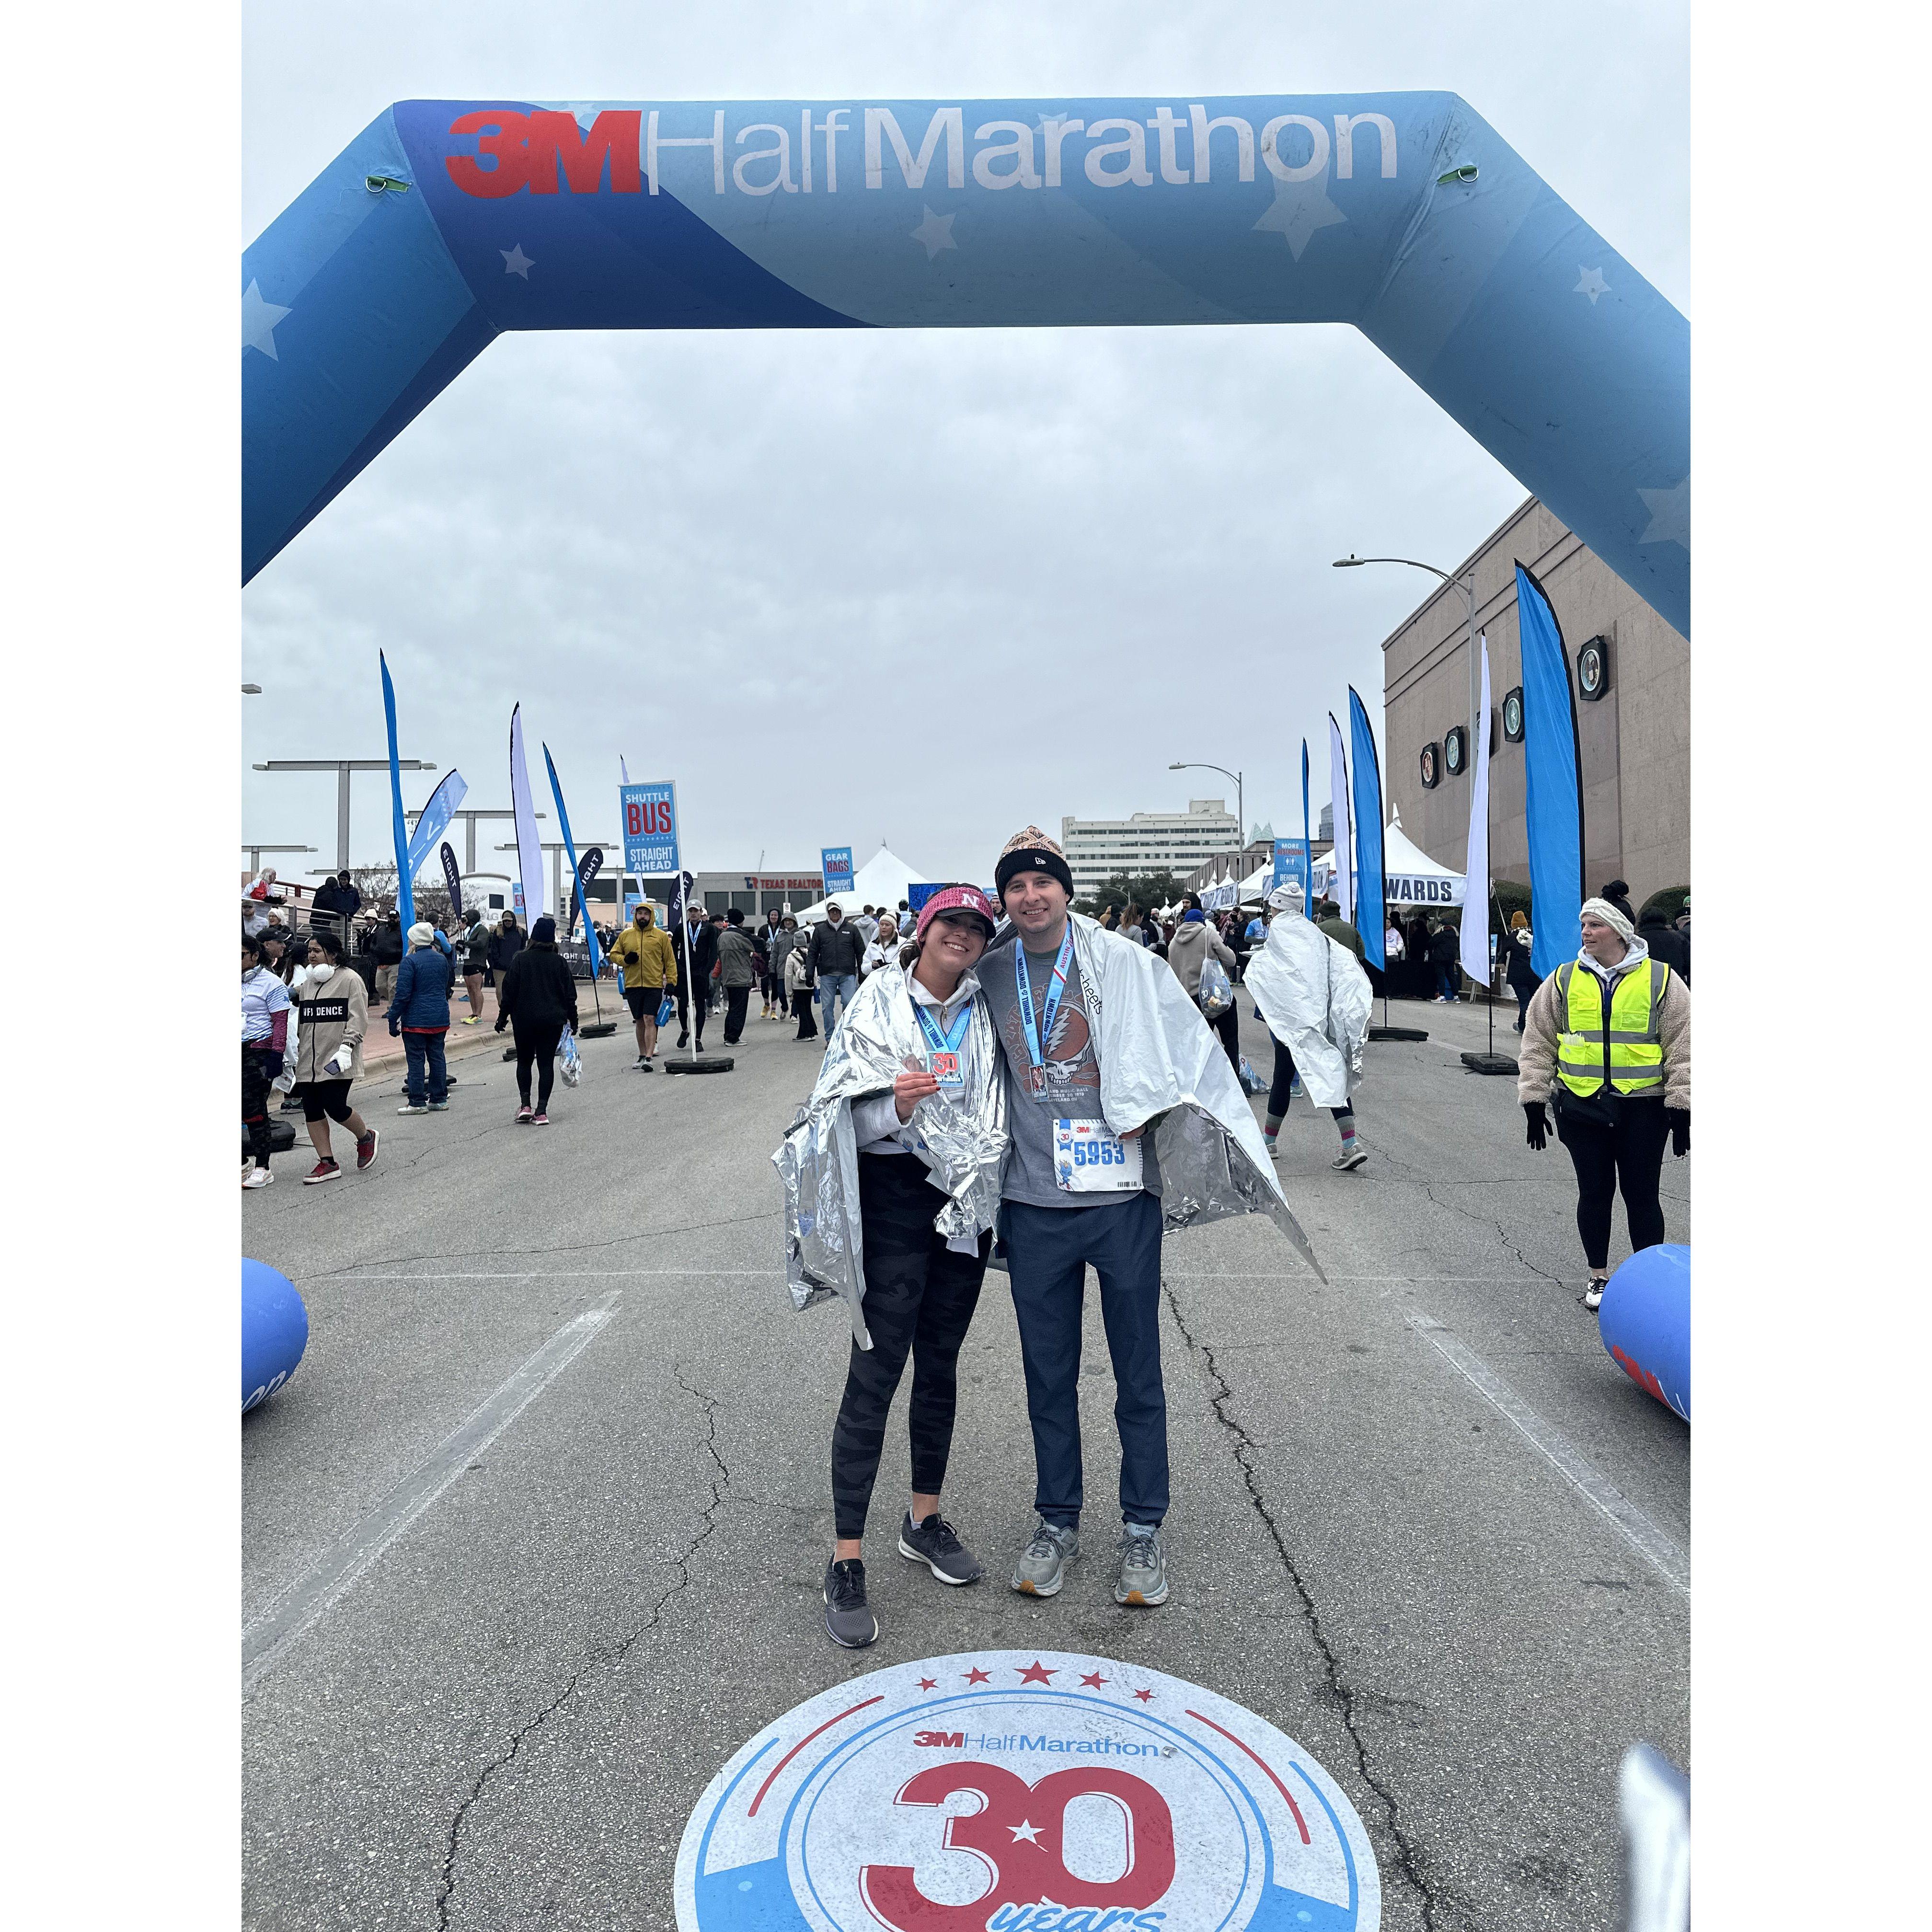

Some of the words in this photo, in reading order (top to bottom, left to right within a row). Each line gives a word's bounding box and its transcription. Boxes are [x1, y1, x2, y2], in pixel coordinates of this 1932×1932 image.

[445, 110, 642, 199] 3M
[647, 108, 851, 196] Half
[864, 104, 1397, 190] Marathon
[625, 792, 670, 804] SHUTTLE
[627, 801, 672, 836] BUS
[630, 847, 673, 862] STRAIGHT
[826, 853, 848, 862] GEAR
[443, 849, 457, 887] EIGHT
[633, 861, 672, 872] AHEAD
[827, 860, 849, 873] BAGS
[760, 879, 785, 889] TEXAS
[828, 879, 851, 887] STRAIGHT
[1386, 879, 1452, 902] WARDS
[961, 893, 978, 909] N
[1060, 946, 1070, 969] AUSTIN
[1017, 957, 1027, 990] DOWNTOWN
[1022, 996, 1033, 1025] DOWNHILL
[1044, 998, 1056, 1032] DOWNTOWN
[928, 1027, 944, 1048] DOWNHILL
[933, 1053, 957, 1074] 30
[1074, 1141, 1125, 1166] 5953
[913, 1731, 964, 1748] 3M
[964, 1734, 1018, 1751] Half
[1018, 1735, 1159, 1757] Marathon
[858, 1761, 1176, 1932] 30
